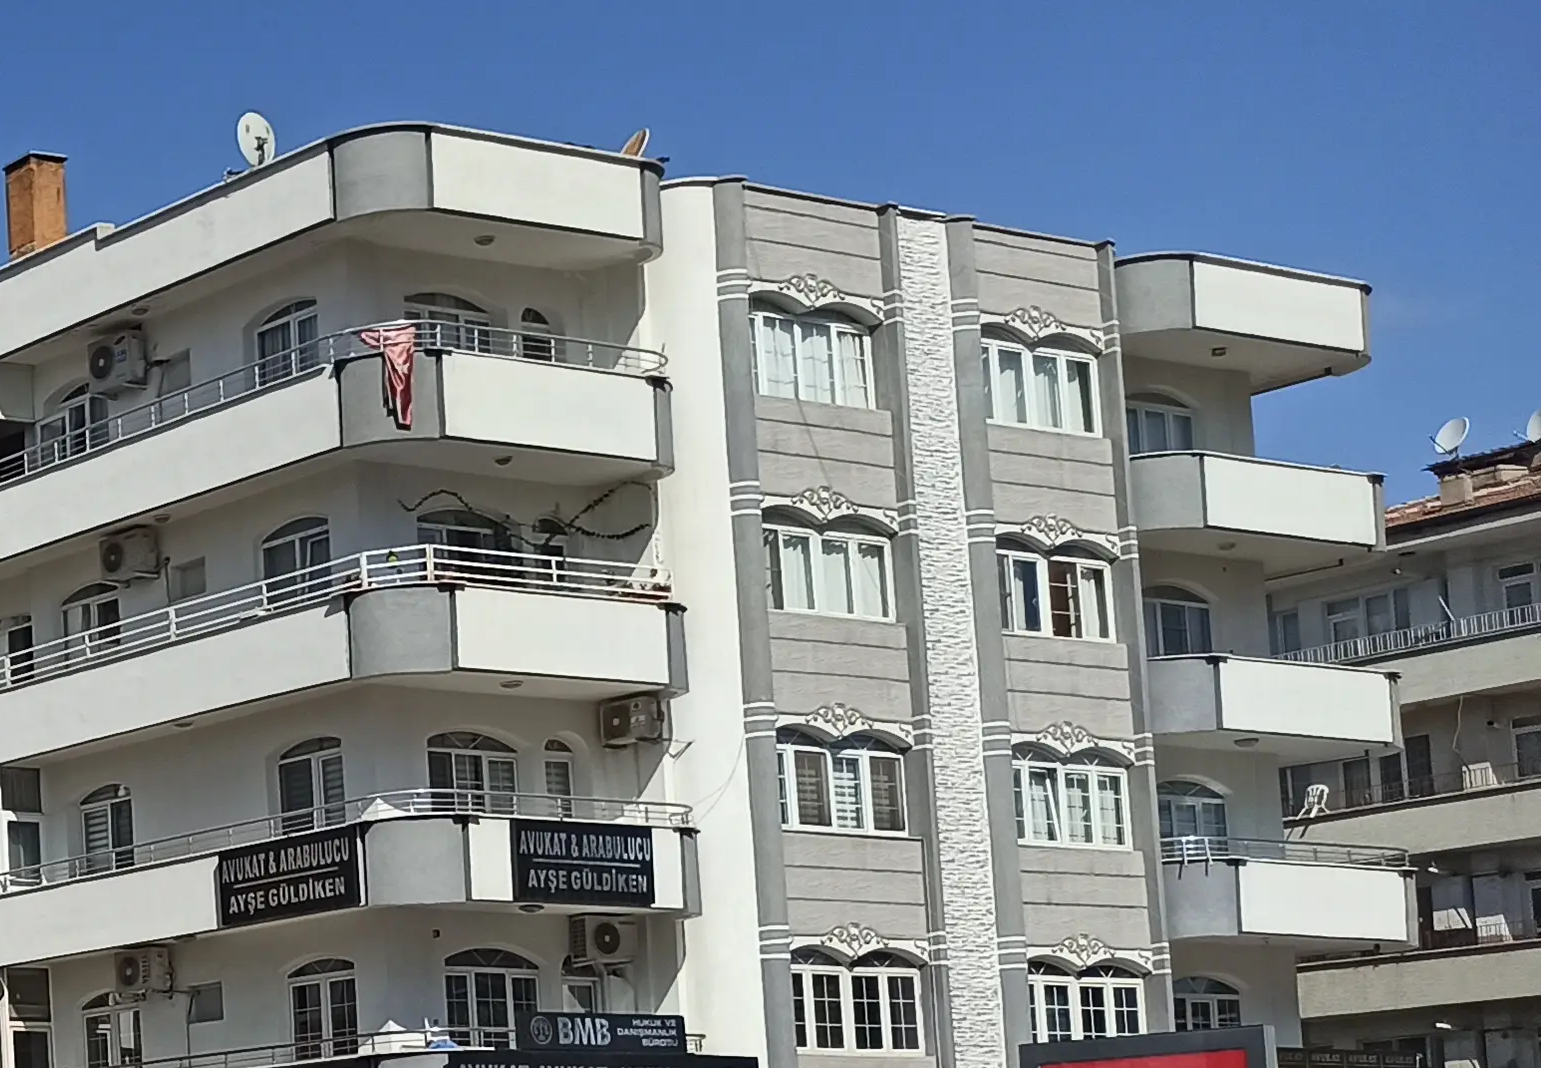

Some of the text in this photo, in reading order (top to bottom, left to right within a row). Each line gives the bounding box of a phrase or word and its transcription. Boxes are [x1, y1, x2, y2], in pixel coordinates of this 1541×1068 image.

[222, 837, 350, 884] AVUKAT & ARABULUCU
[519, 830, 651, 861] AVUKAT & ARABULUCU
[228, 876, 345, 915] AYŞE GÜLDİKEN
[528, 868, 647, 893] AYŞE GÜLDİKEN
[557, 1017, 611, 1046] BMB
